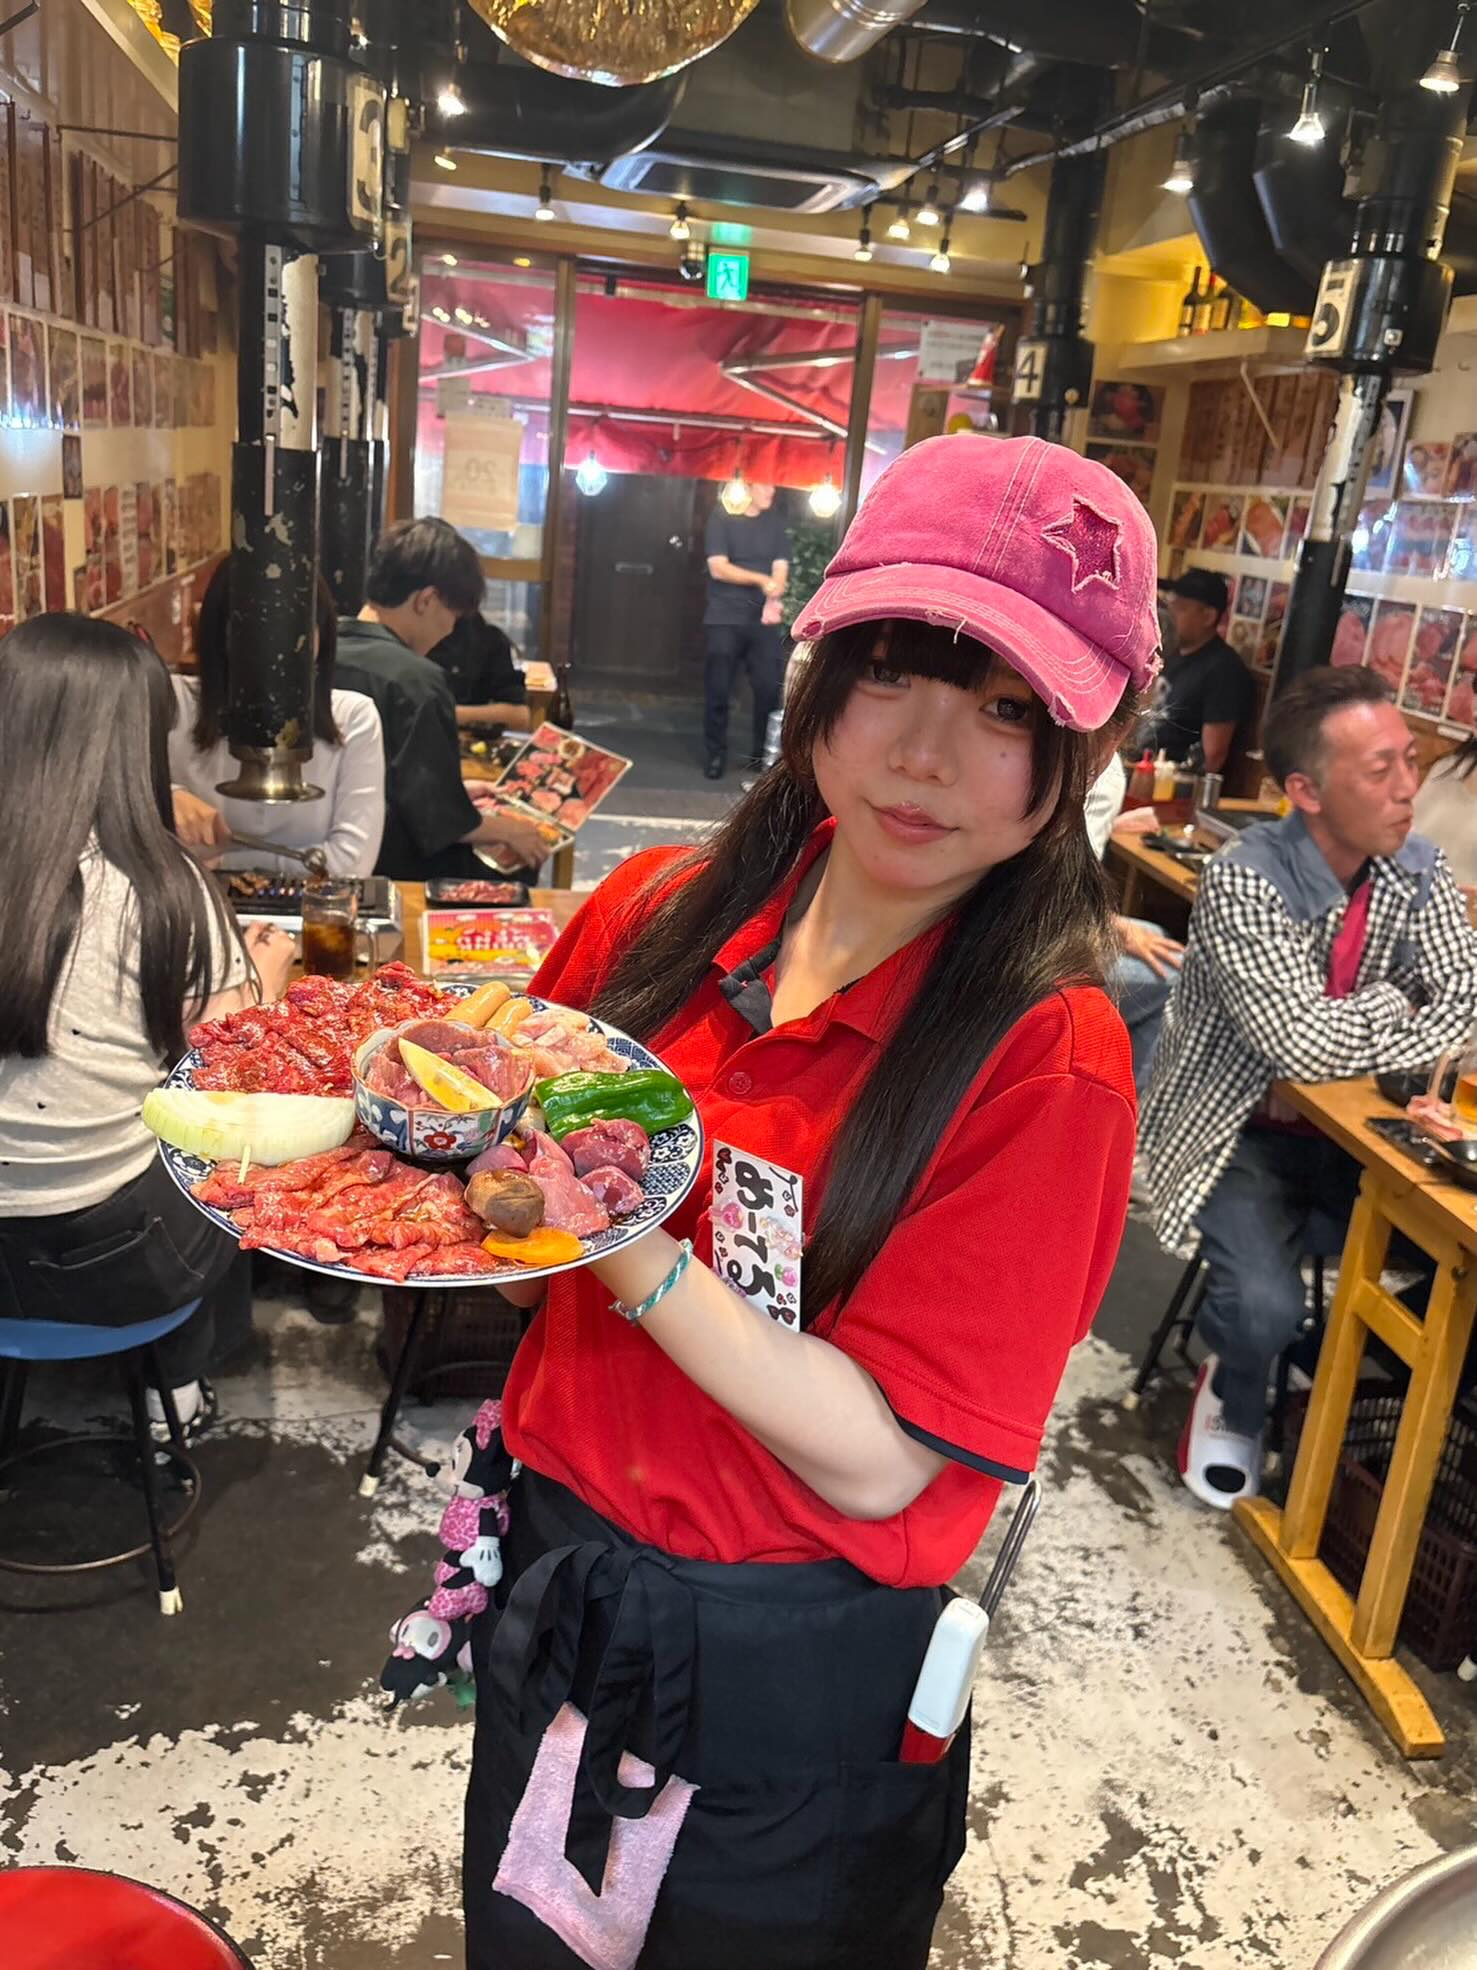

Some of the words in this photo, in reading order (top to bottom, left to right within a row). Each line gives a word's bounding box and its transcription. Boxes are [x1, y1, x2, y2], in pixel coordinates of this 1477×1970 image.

[359, 99, 382, 217] 3
[389, 236, 407, 294] 2
[1015, 350, 1038, 393] 4
